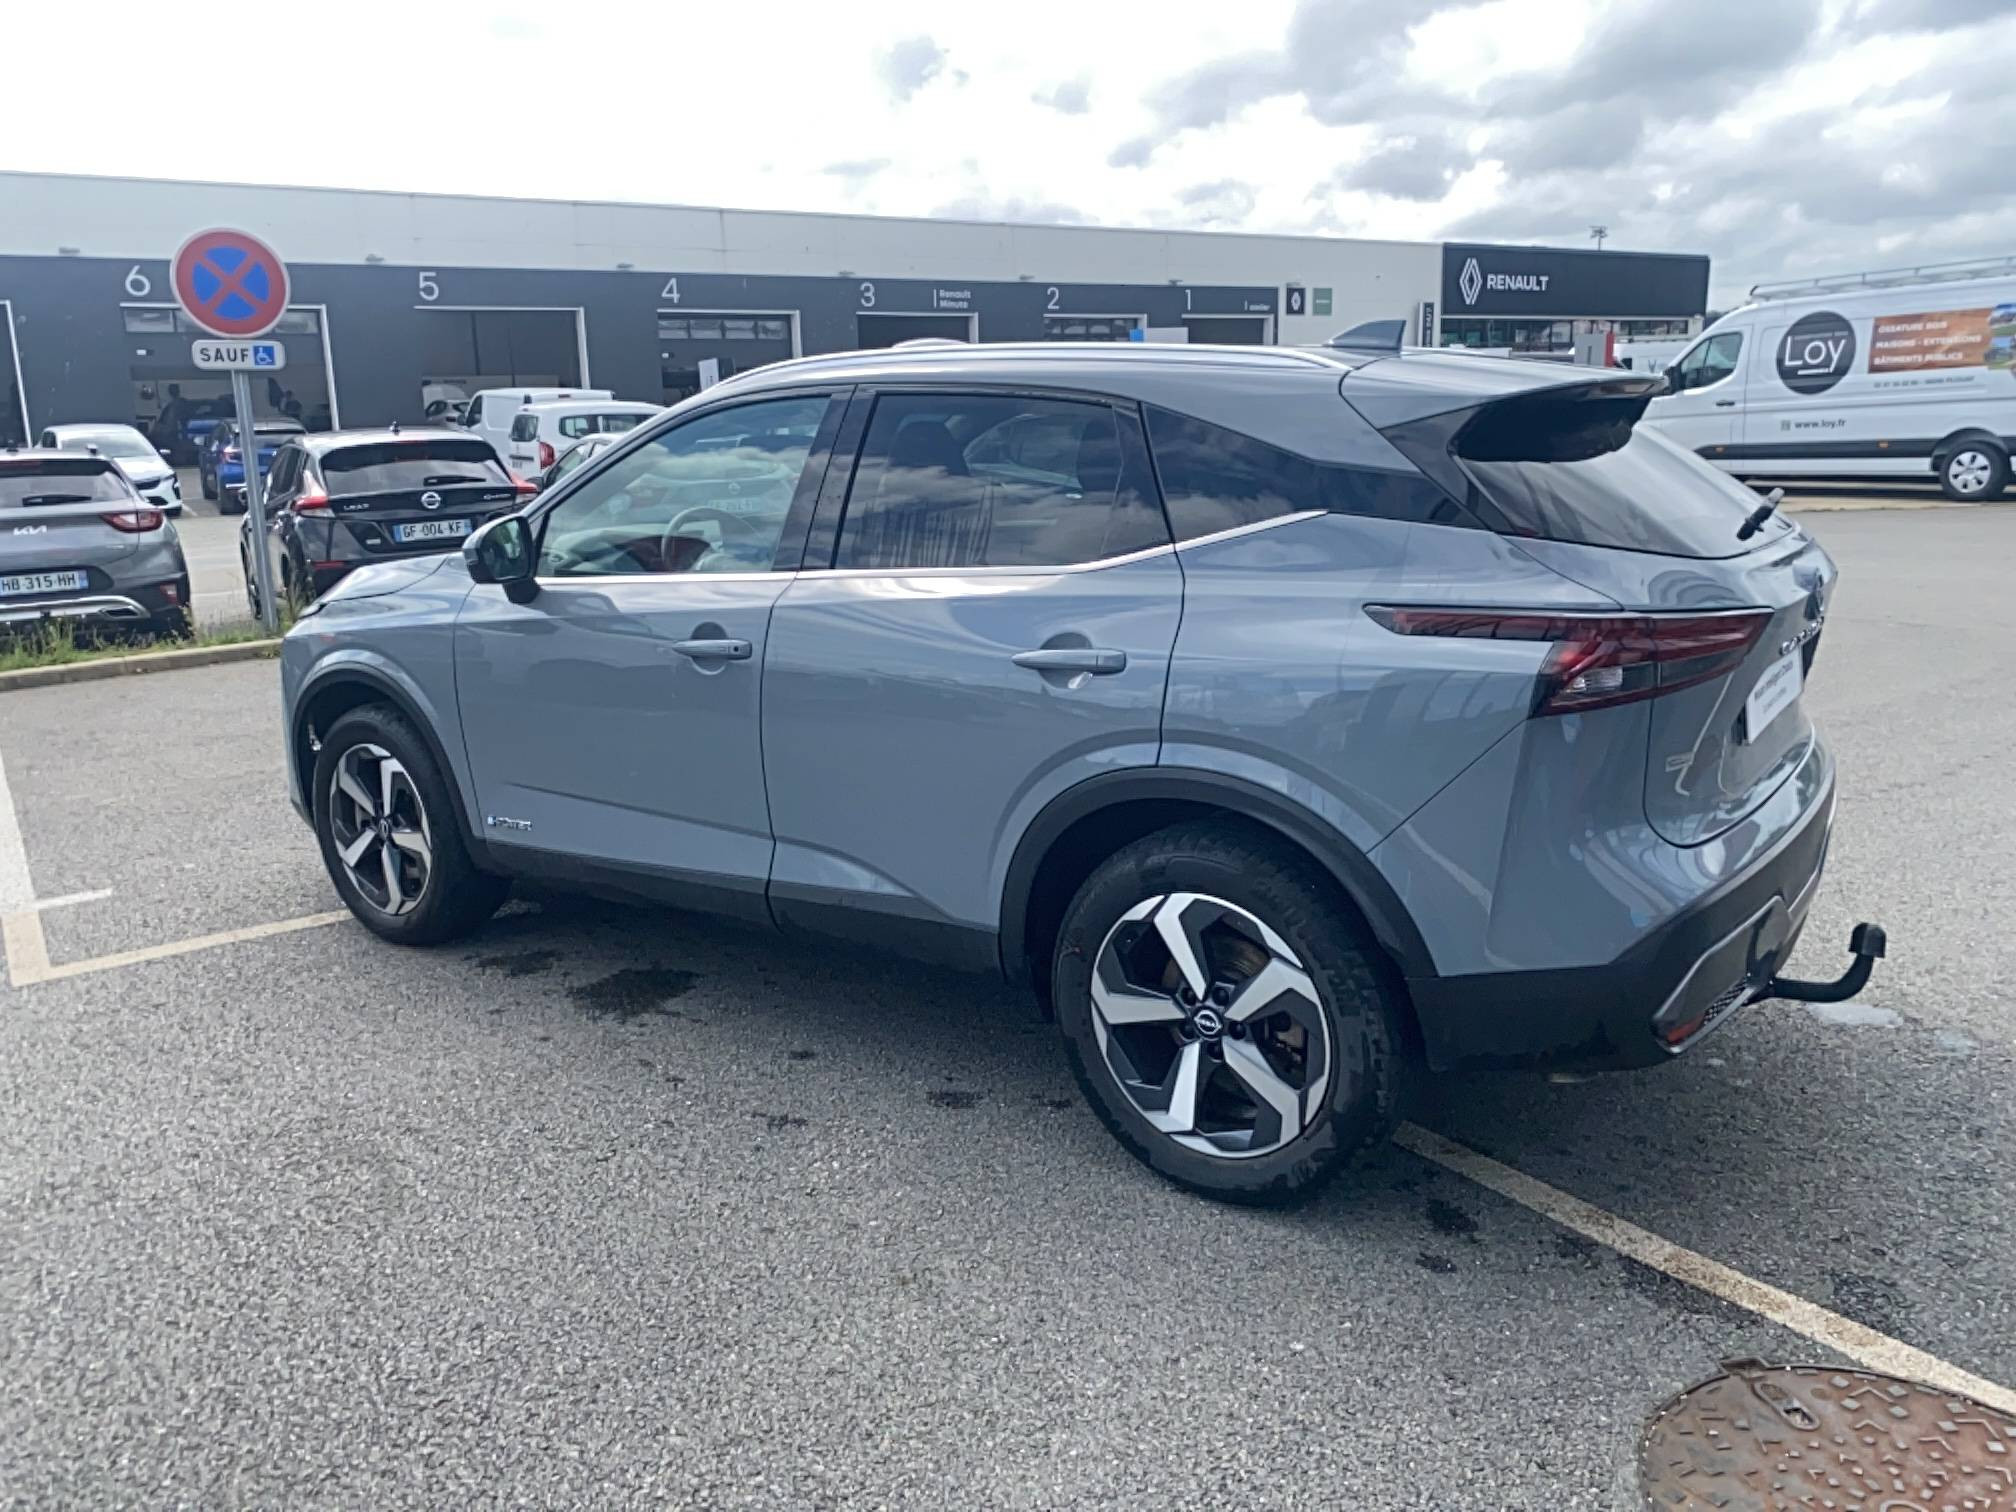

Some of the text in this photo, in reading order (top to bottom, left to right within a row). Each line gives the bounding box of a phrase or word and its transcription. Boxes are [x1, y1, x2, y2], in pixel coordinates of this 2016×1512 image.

[125, 265, 151, 296] 6
[419, 271, 439, 301] 5
[661, 277, 680, 304] 4
[1486, 273, 1549, 291] RENAULT
[860, 282, 875, 307] 3
[1047, 287, 1060, 310] 2
[1185, 289, 1192, 311] 1
[1875, 338, 1916, 349] MAISONS
[1923, 334, 1982, 347] EXTENSIONS
[199, 347, 249, 363] SAUF
[1794, 418, 1847, 430] www.loy.fr
